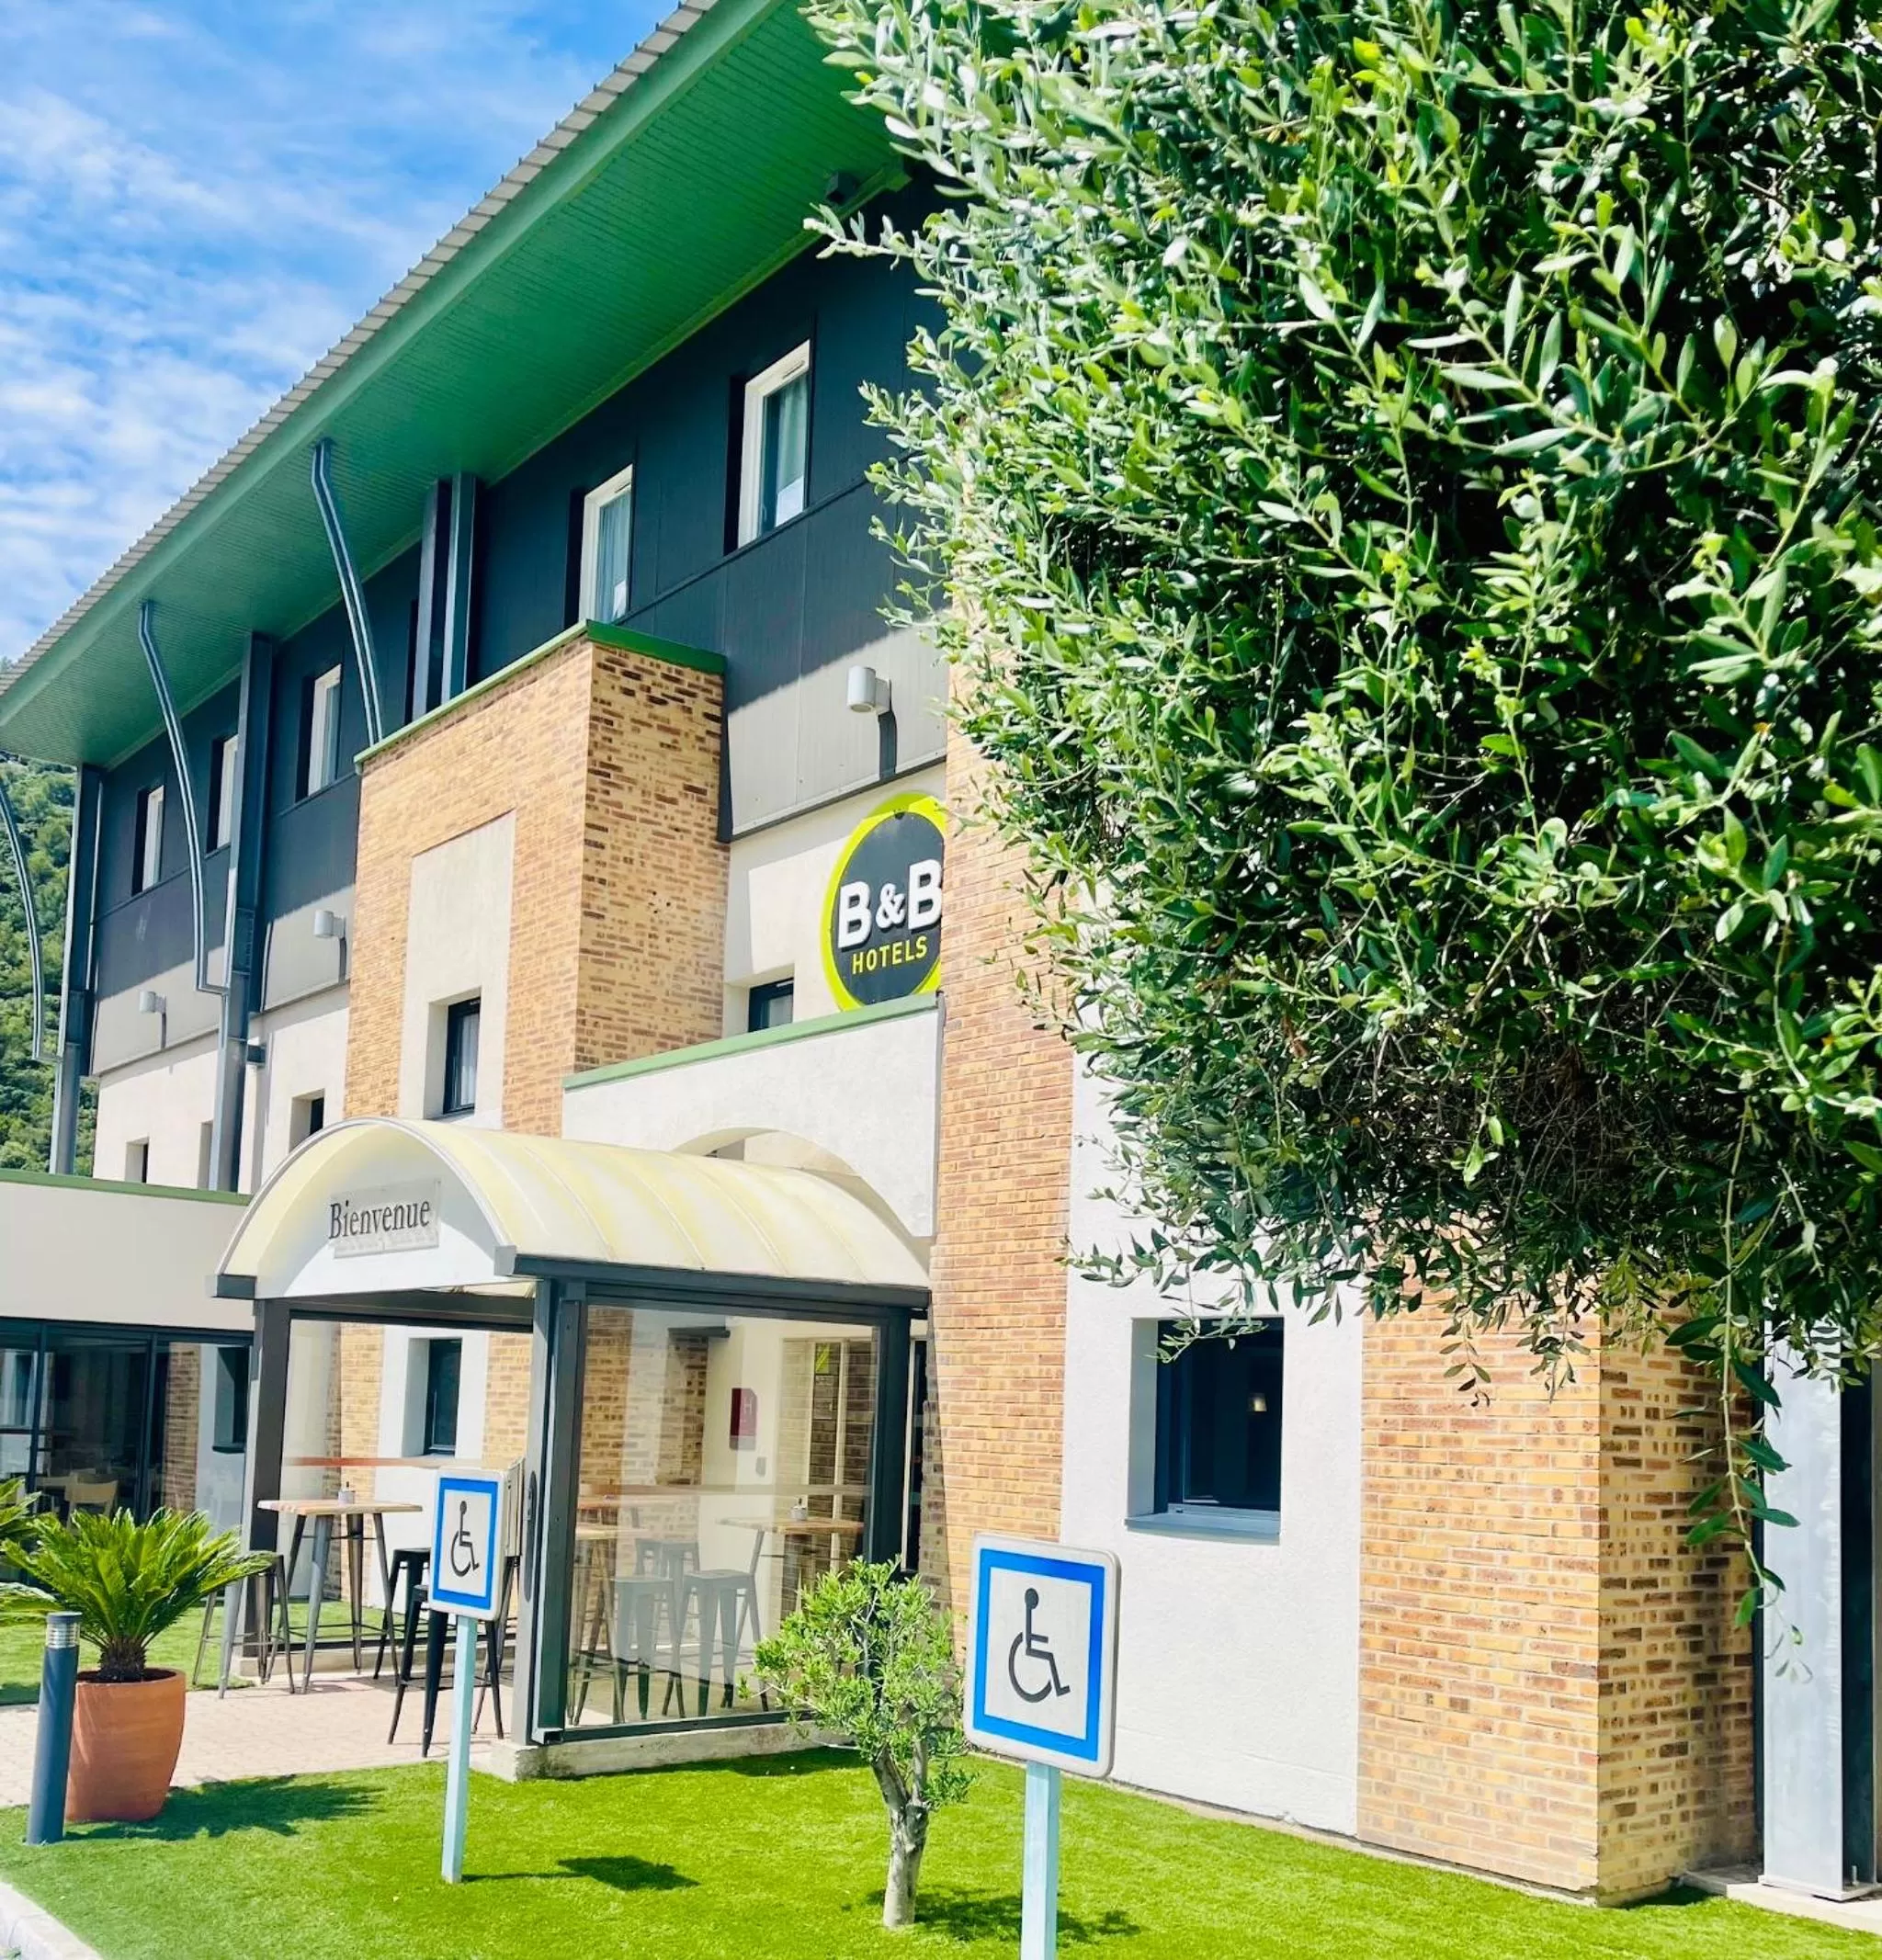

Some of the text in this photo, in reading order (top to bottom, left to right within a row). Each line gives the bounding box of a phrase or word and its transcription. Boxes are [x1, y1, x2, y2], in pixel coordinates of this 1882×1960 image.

[838, 859, 942, 948] B&B
[852, 935, 928, 974] HOTELS
[328, 1200, 431, 1240] Bienvenue
